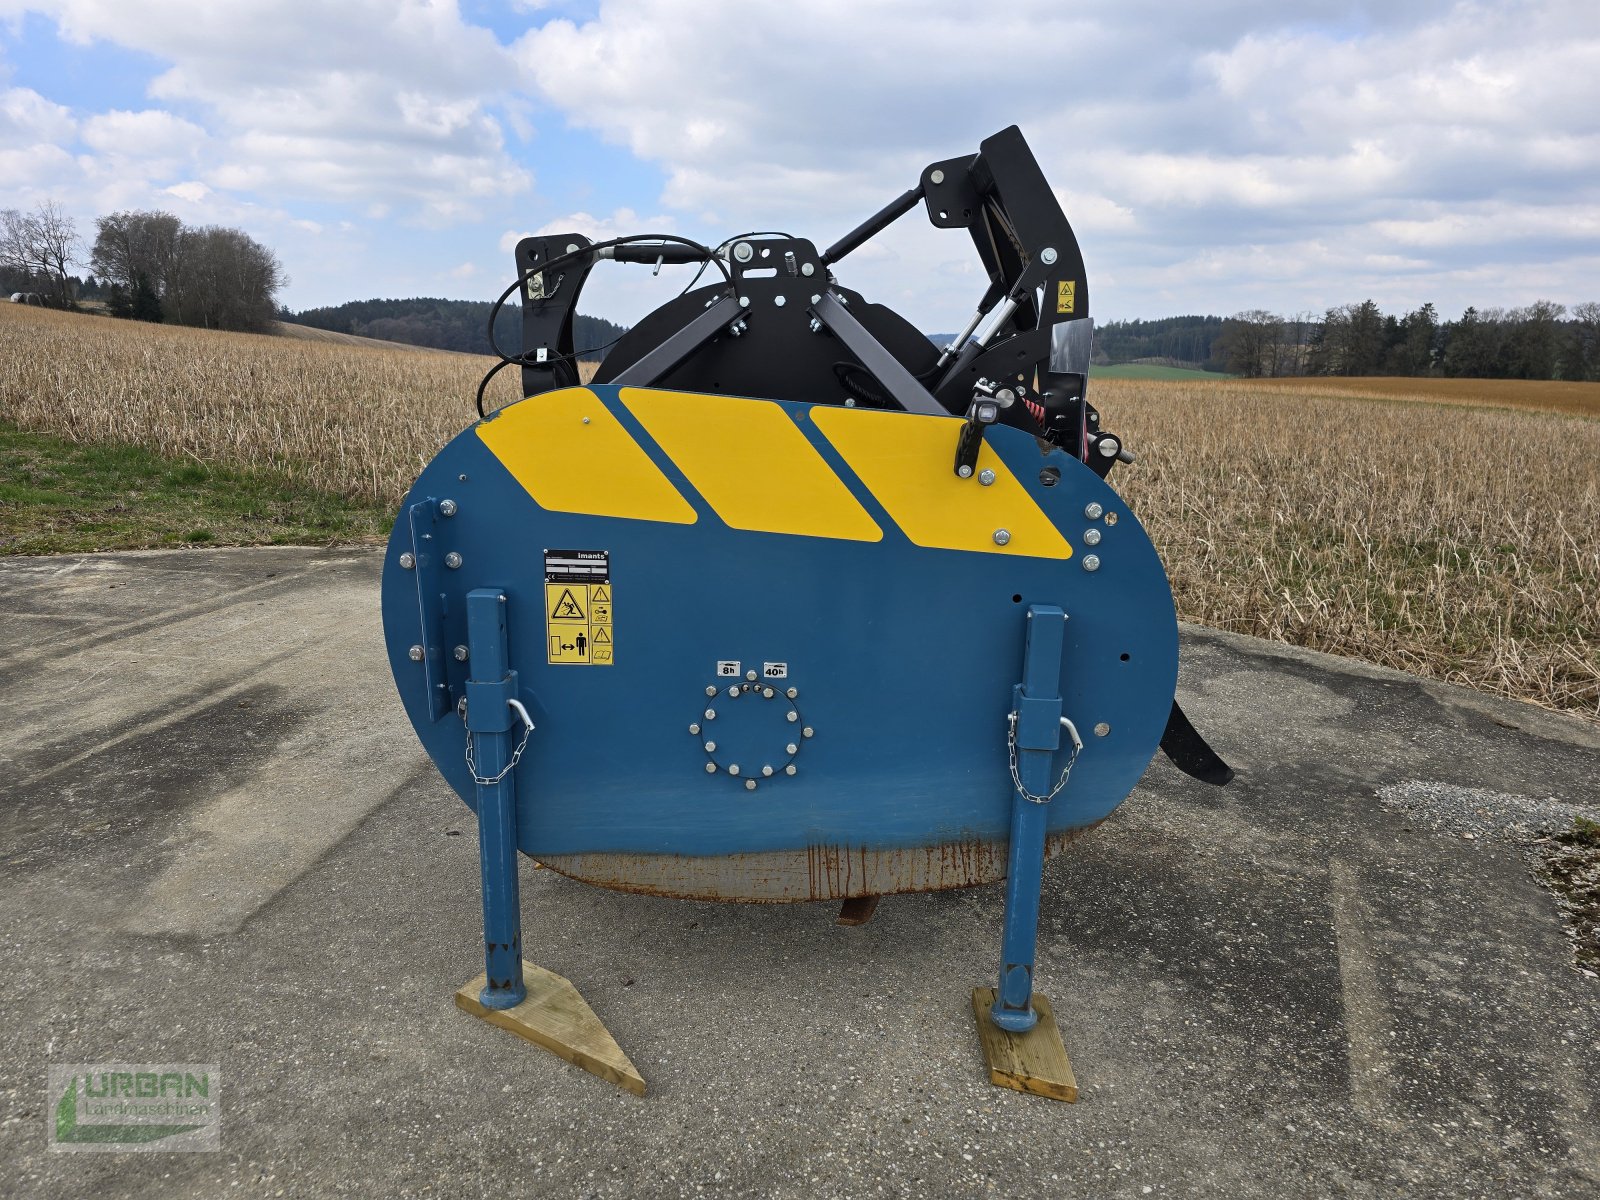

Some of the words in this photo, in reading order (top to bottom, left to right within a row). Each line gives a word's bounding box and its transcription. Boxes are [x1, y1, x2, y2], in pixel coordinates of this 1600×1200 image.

[577, 552, 605, 560] imants
[722, 666, 735, 675] 8h
[765, 668, 784, 676] 40h
